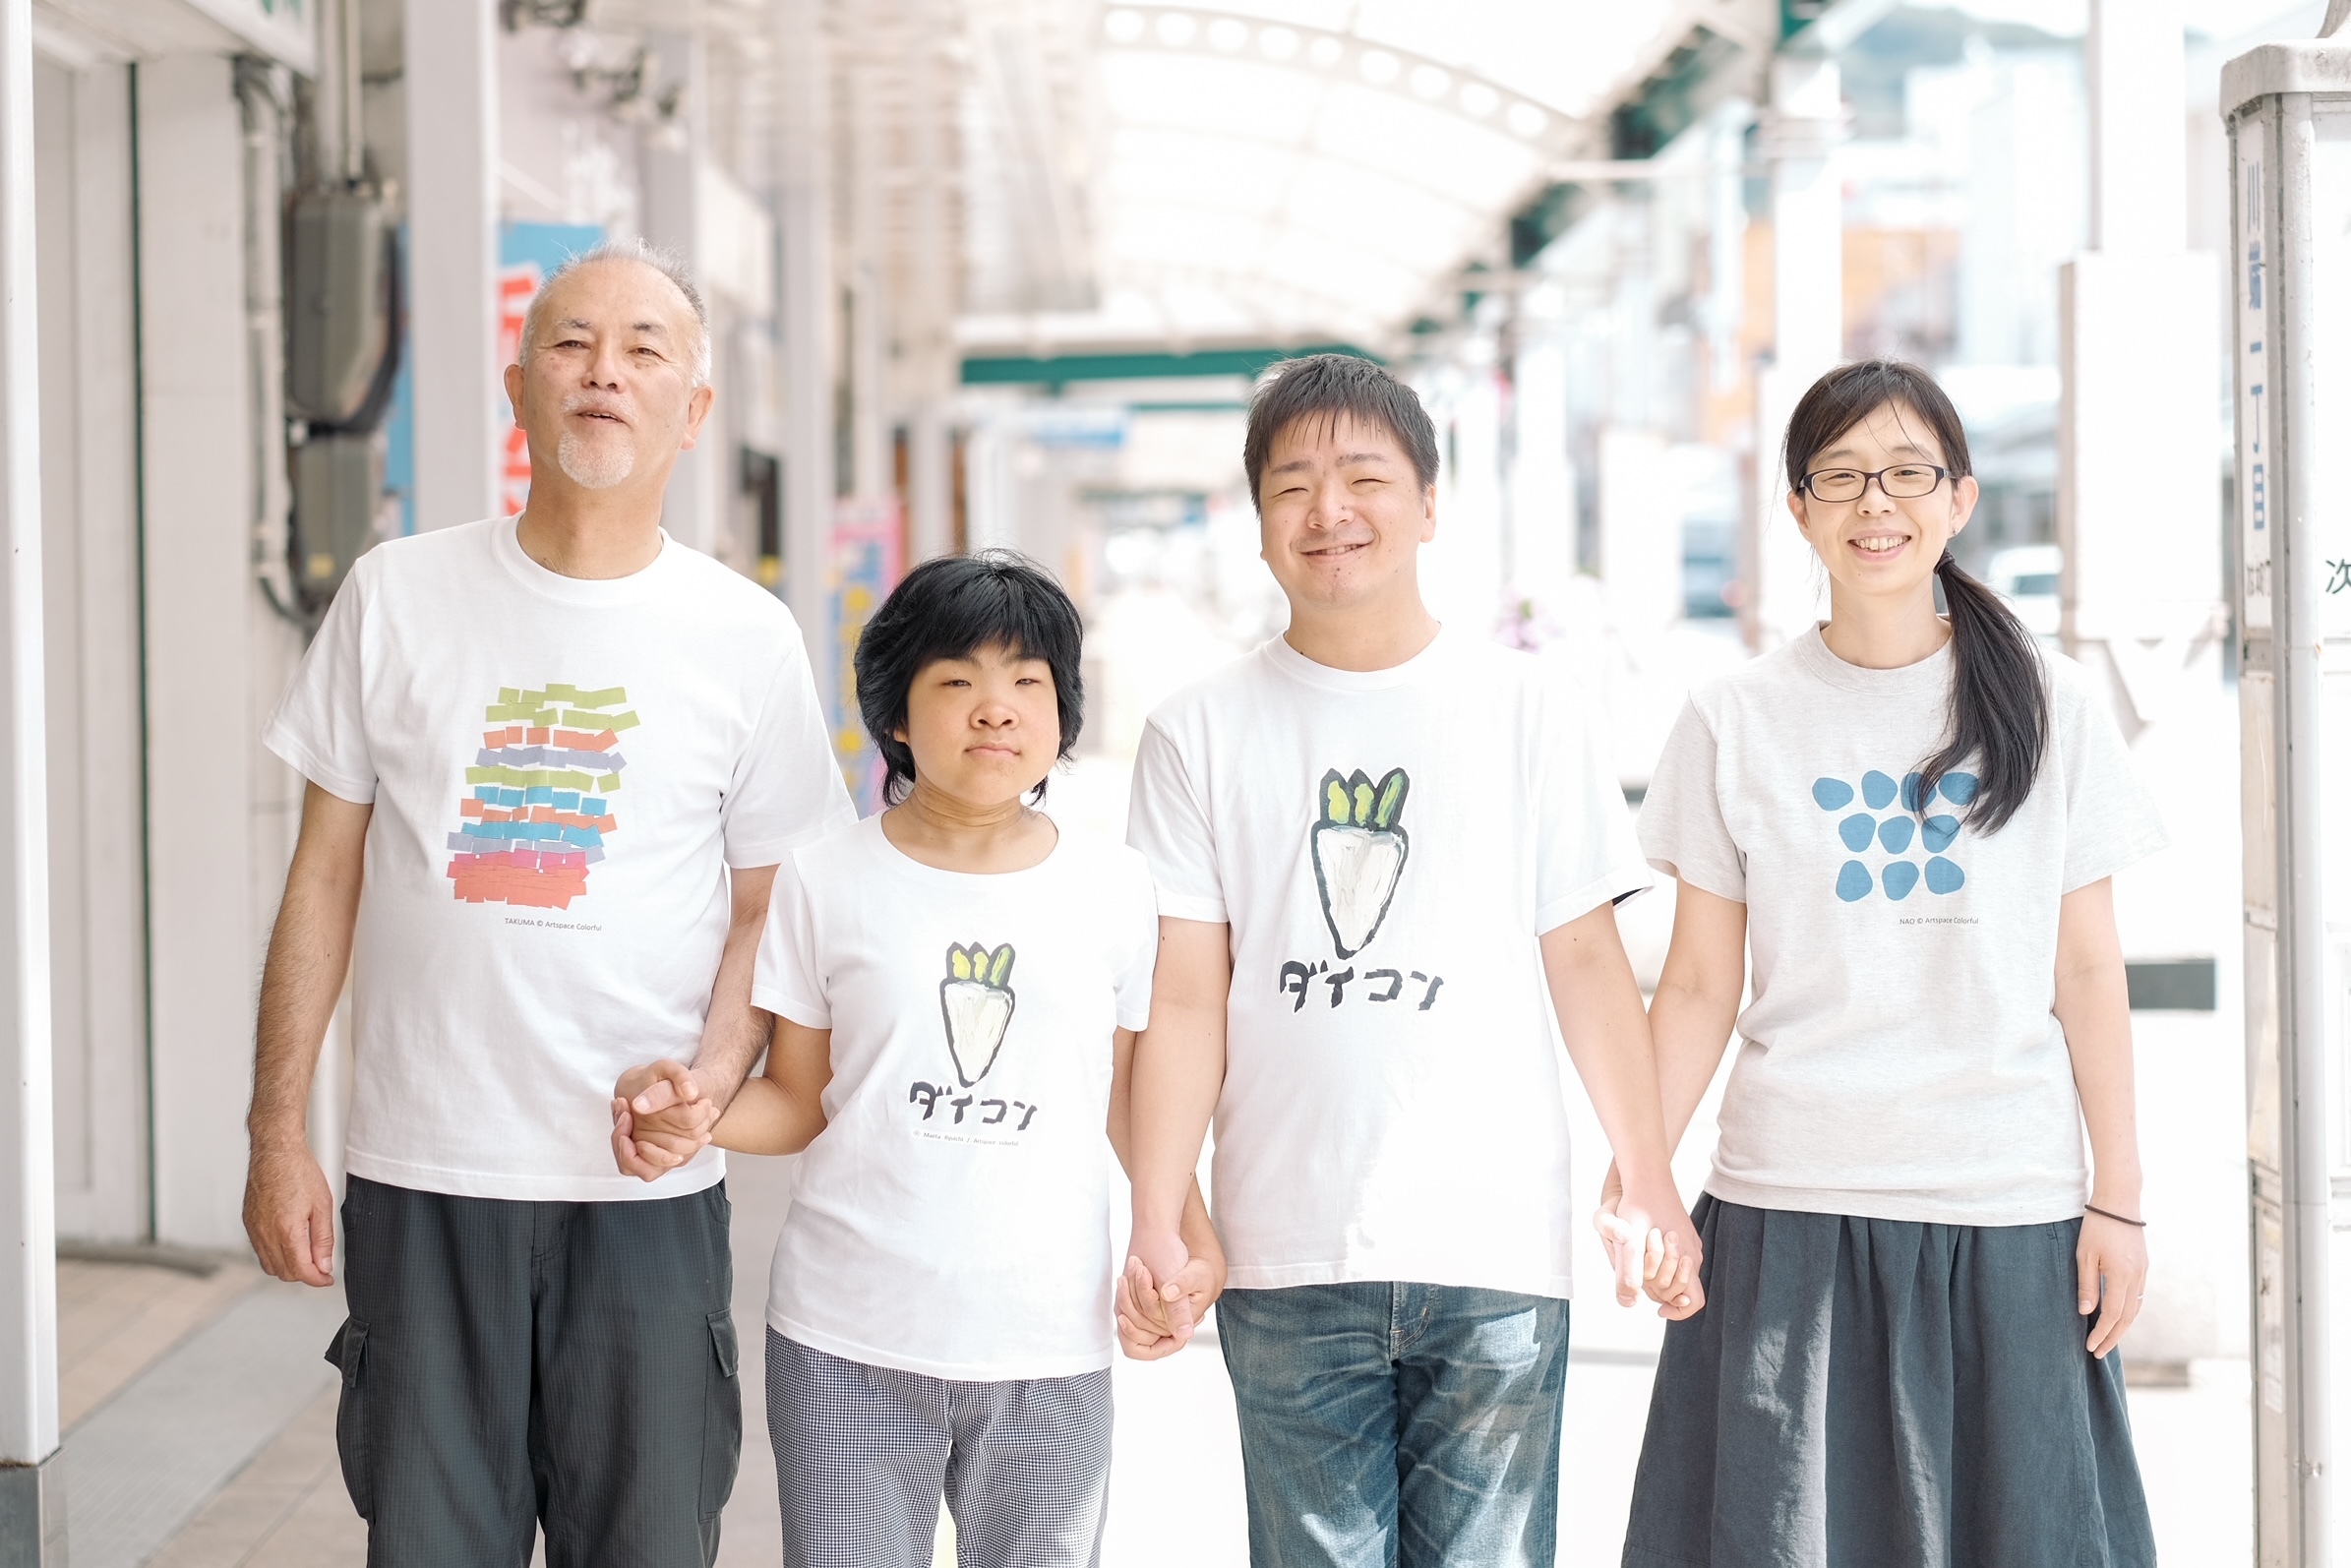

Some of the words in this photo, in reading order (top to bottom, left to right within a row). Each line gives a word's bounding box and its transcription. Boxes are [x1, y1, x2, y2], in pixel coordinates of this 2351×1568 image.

[505, 917, 535, 927] TAKUMA
[545, 921, 575, 930] Artspace
[575, 923, 603, 932] Colorful
[1280, 959, 1444, 1013] ダイコン
[909, 1081, 1038, 1131] ダイコン
[923, 1131, 941, 1140] Maeta
